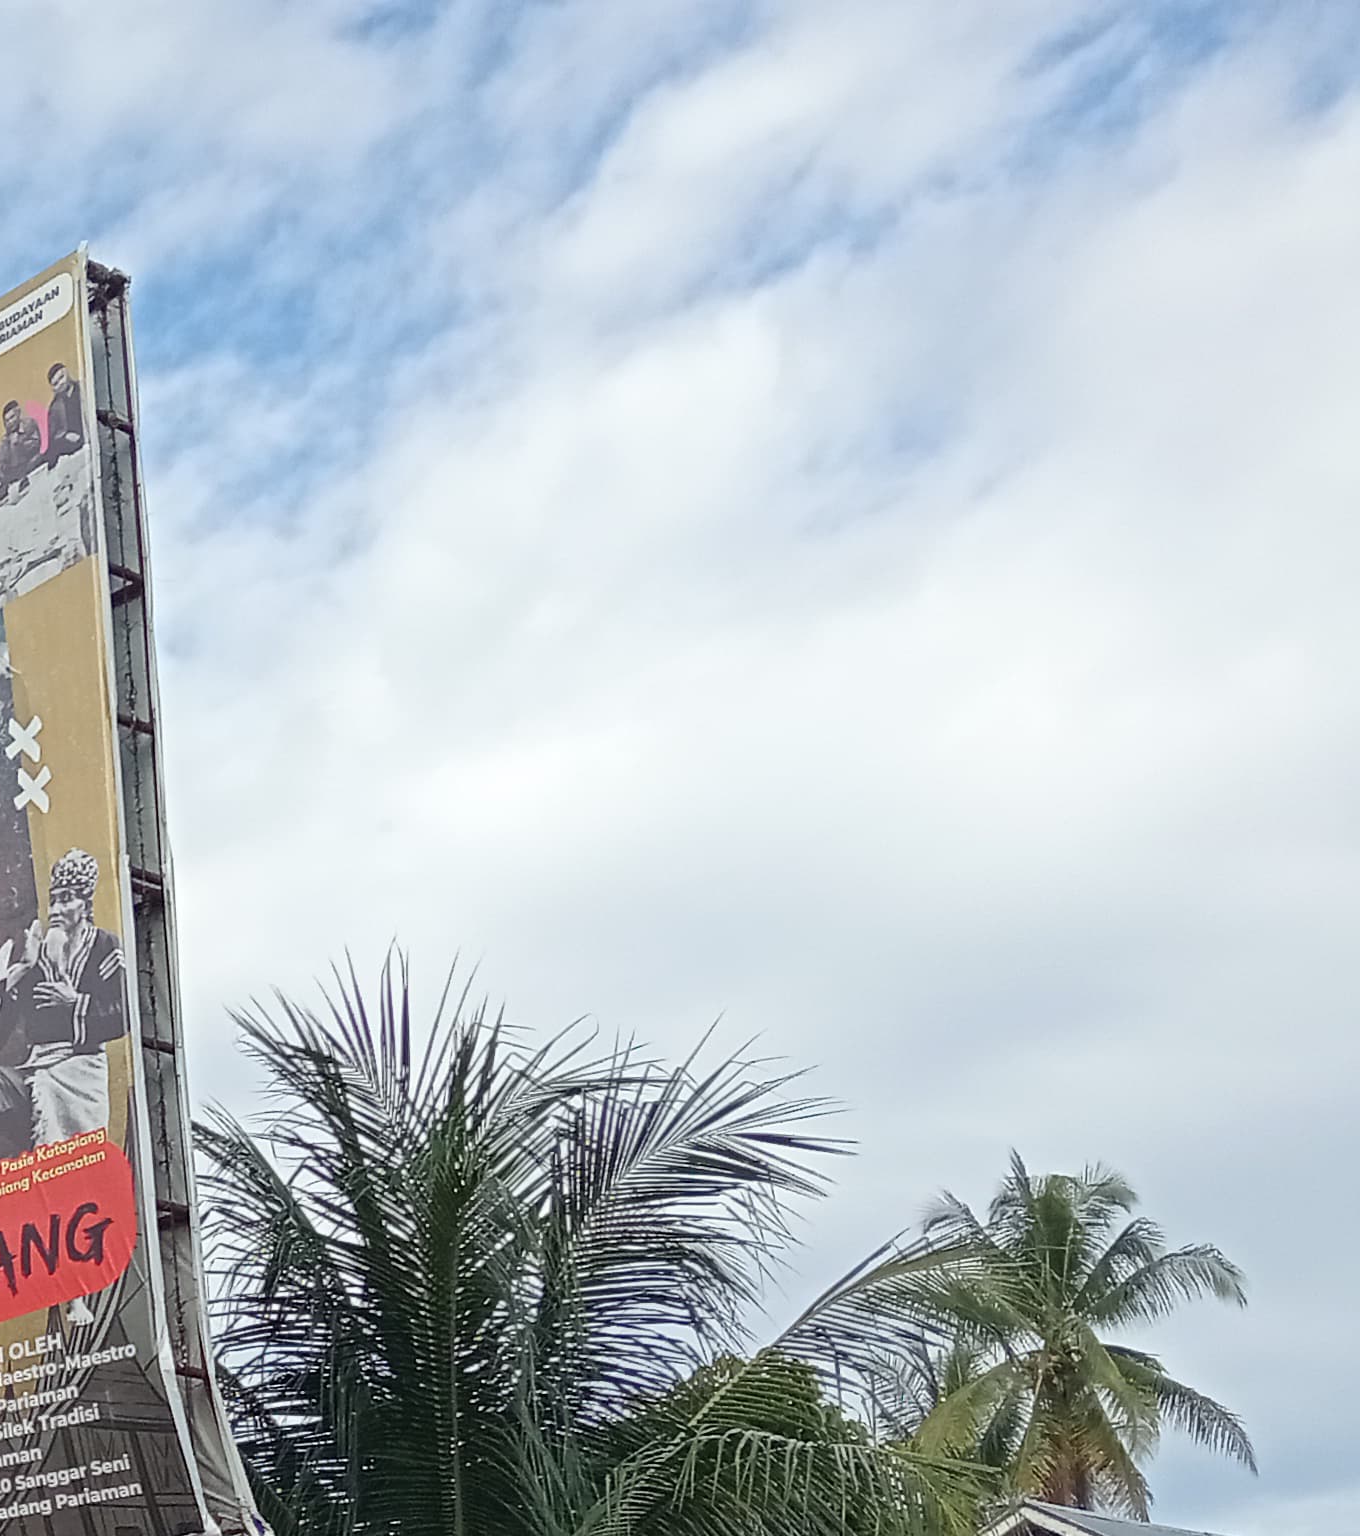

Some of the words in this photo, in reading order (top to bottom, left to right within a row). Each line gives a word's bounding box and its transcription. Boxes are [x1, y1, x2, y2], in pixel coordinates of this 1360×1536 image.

[36, 1129, 105, 1161] Katapiang
[8, 1332, 63, 1361] OLEH
[38, 1402, 101, 1431] Tradisi
[15, 1464, 87, 1493] Sanggar
[91, 1453, 130, 1475] Seni
[55, 1481, 143, 1510] Pariaman
